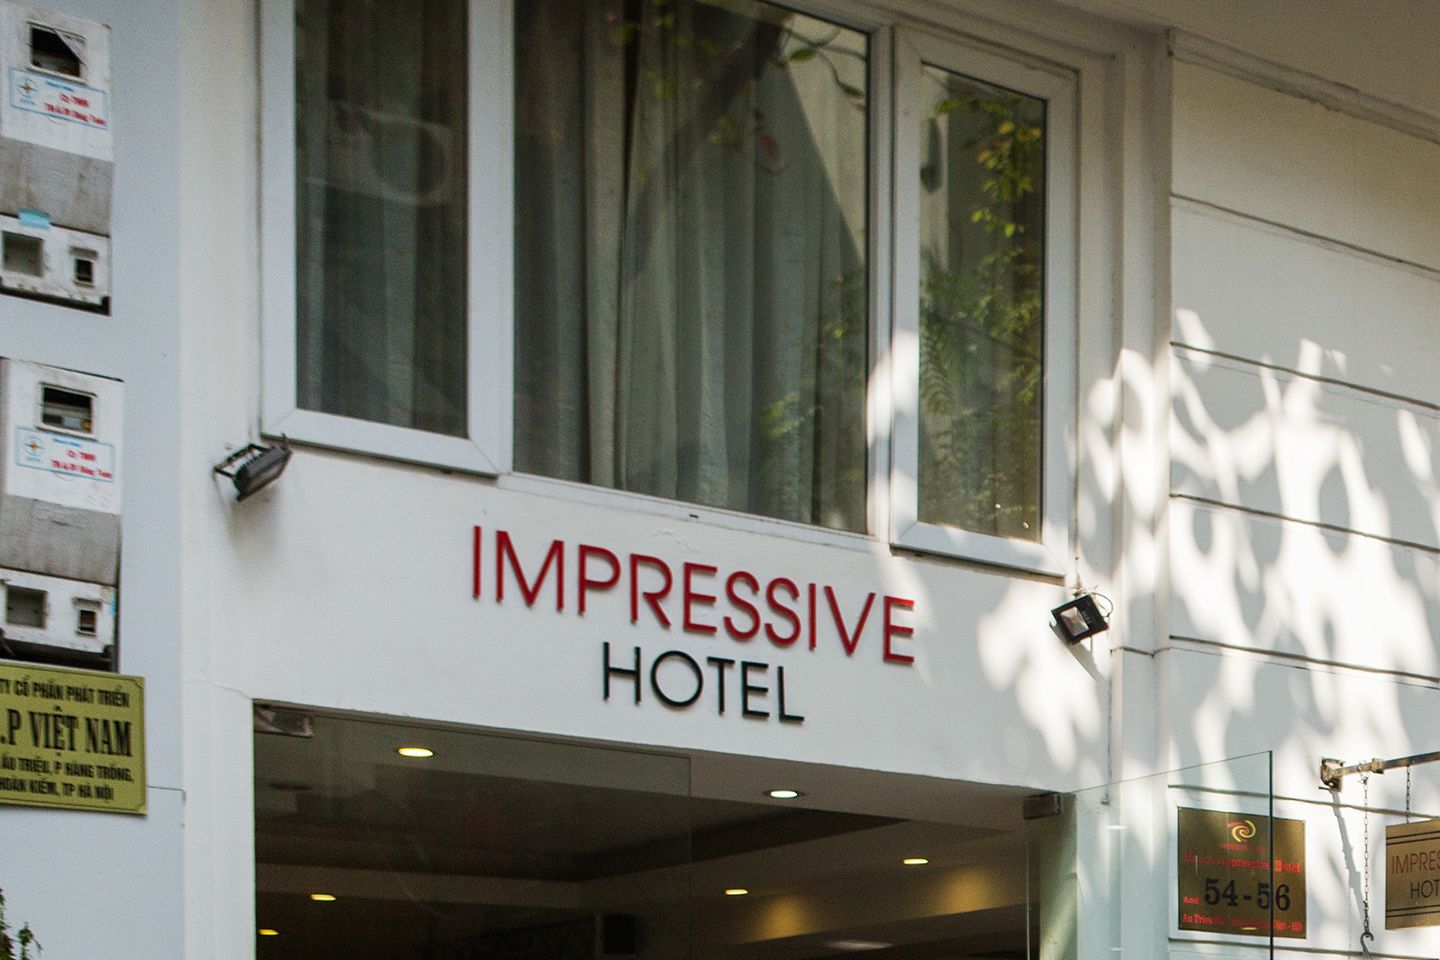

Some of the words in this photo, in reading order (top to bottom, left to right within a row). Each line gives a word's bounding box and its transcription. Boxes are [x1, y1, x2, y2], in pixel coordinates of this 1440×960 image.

[472, 525, 916, 664] IMPRESSIVE
[602, 641, 806, 723] HOTEL
[28, 704, 79, 757] VIỆT
[84, 716, 133, 757] NAM
[61, 782, 75, 797] TP
